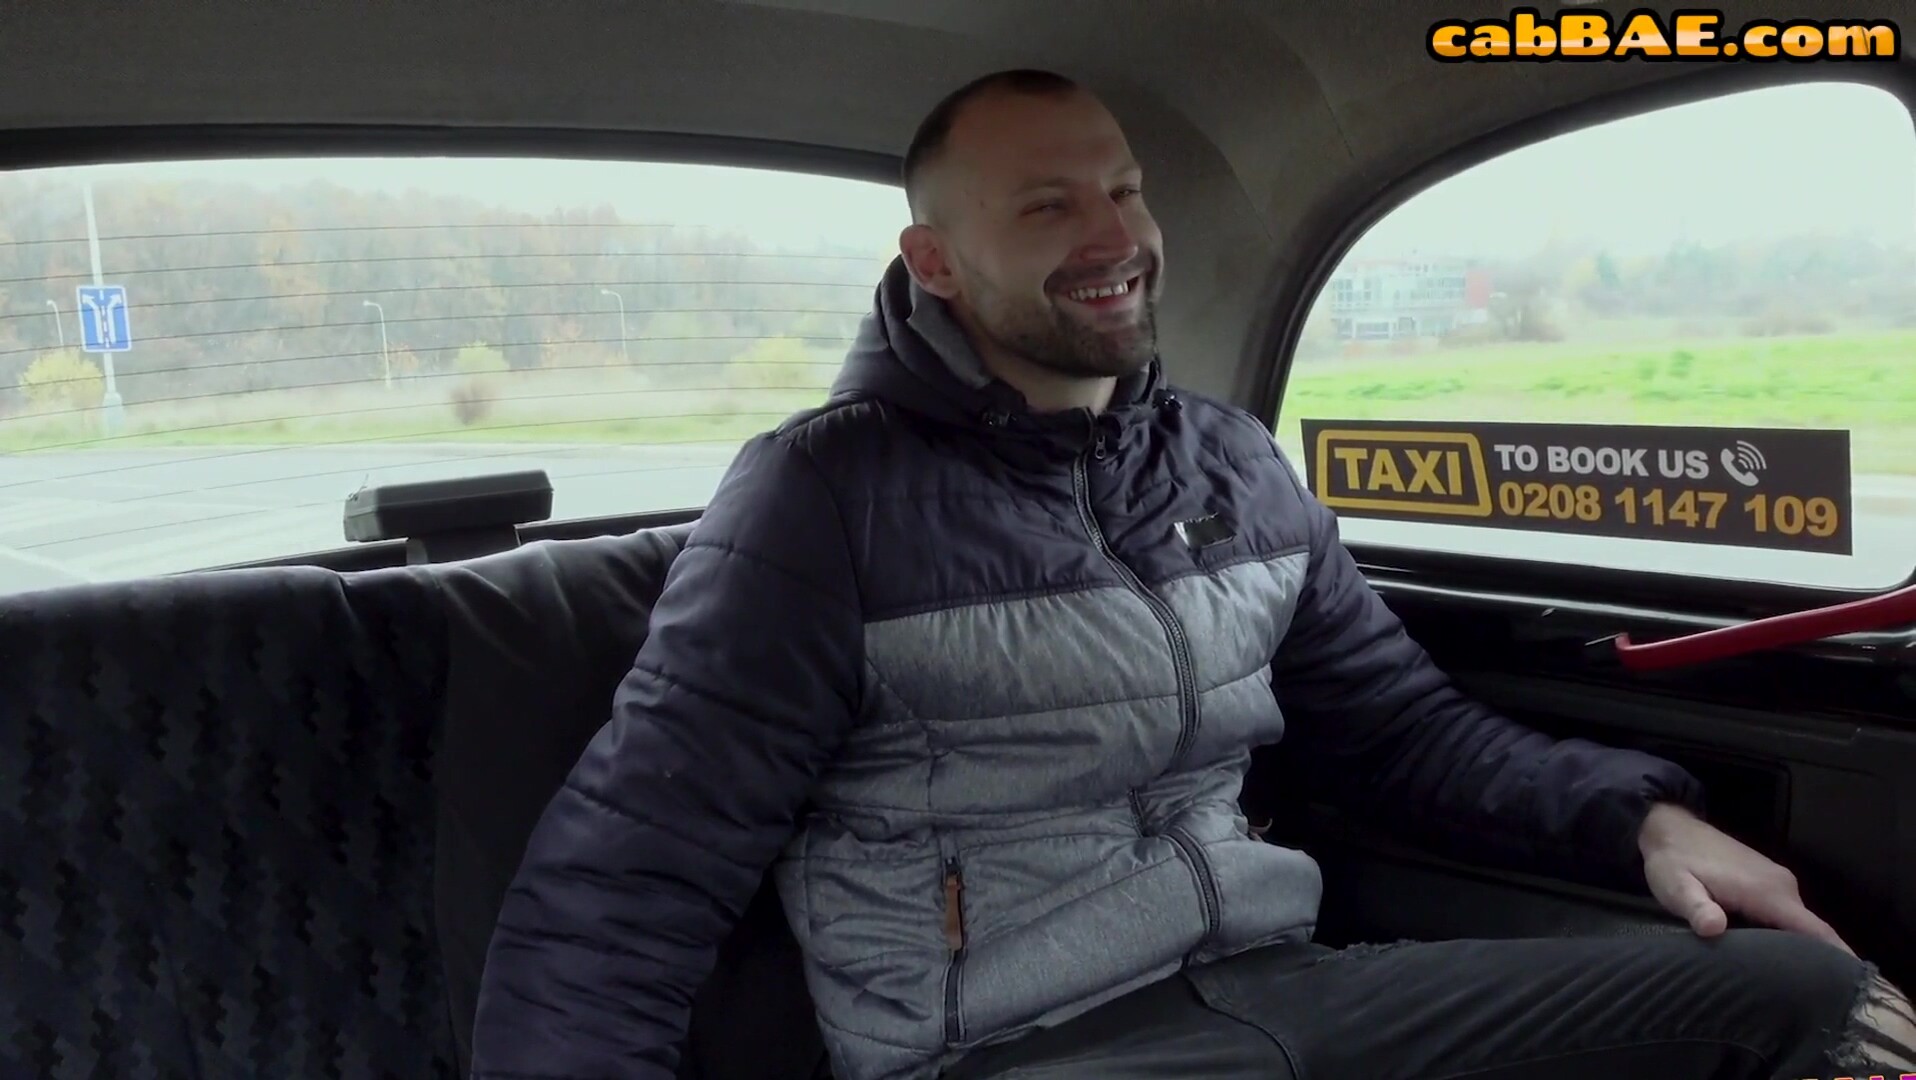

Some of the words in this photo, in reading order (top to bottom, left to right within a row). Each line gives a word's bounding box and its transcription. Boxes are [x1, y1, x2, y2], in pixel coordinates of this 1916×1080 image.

[1334, 447, 1464, 496] TAXI
[1494, 443, 1539, 472] TO
[1548, 446, 1649, 477] BOOK
[1657, 449, 1709, 480] US
[1499, 482, 1602, 521] 0208
[1614, 488, 1728, 529] 1147
[1743, 496, 1838, 537] 109
